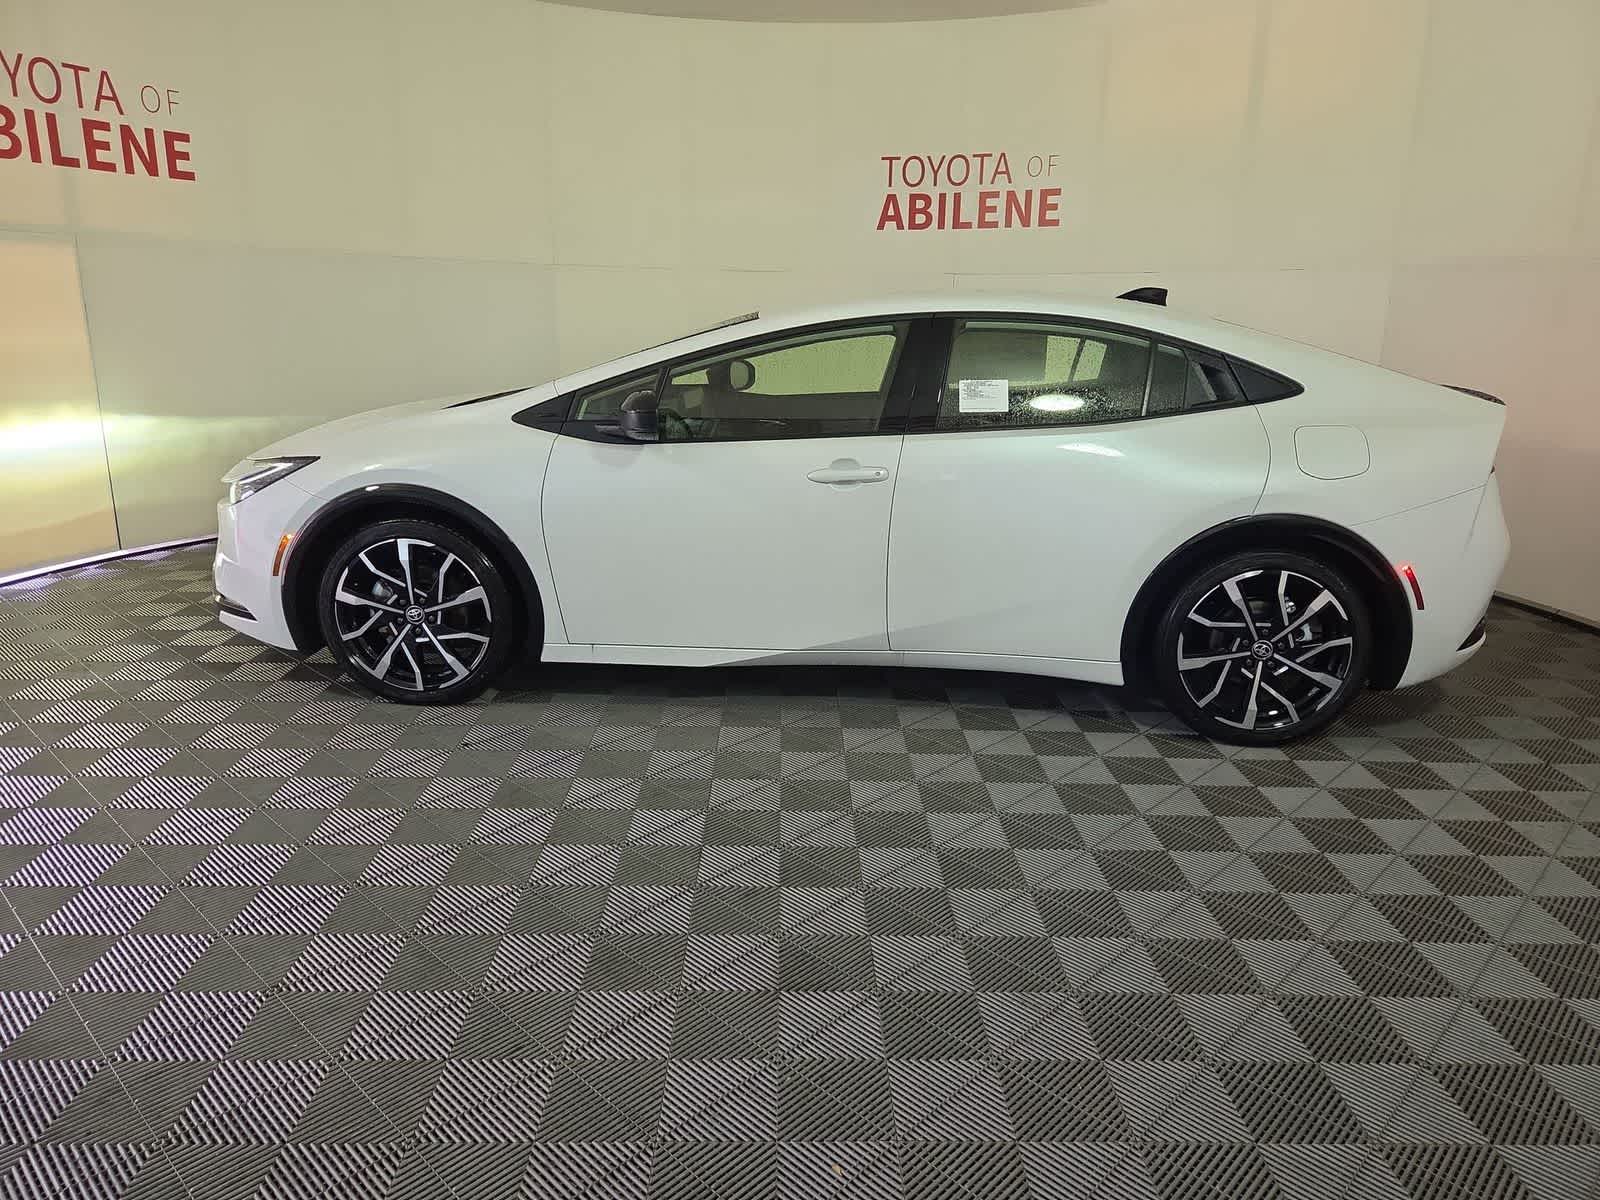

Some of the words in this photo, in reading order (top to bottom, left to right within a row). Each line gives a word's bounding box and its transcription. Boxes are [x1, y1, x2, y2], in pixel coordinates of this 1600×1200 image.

[140, 85, 180, 115] OF
[881, 152, 1013, 188] TOYOTA
[1027, 154, 1060, 178] OF
[876, 187, 1062, 231] ABILENE
